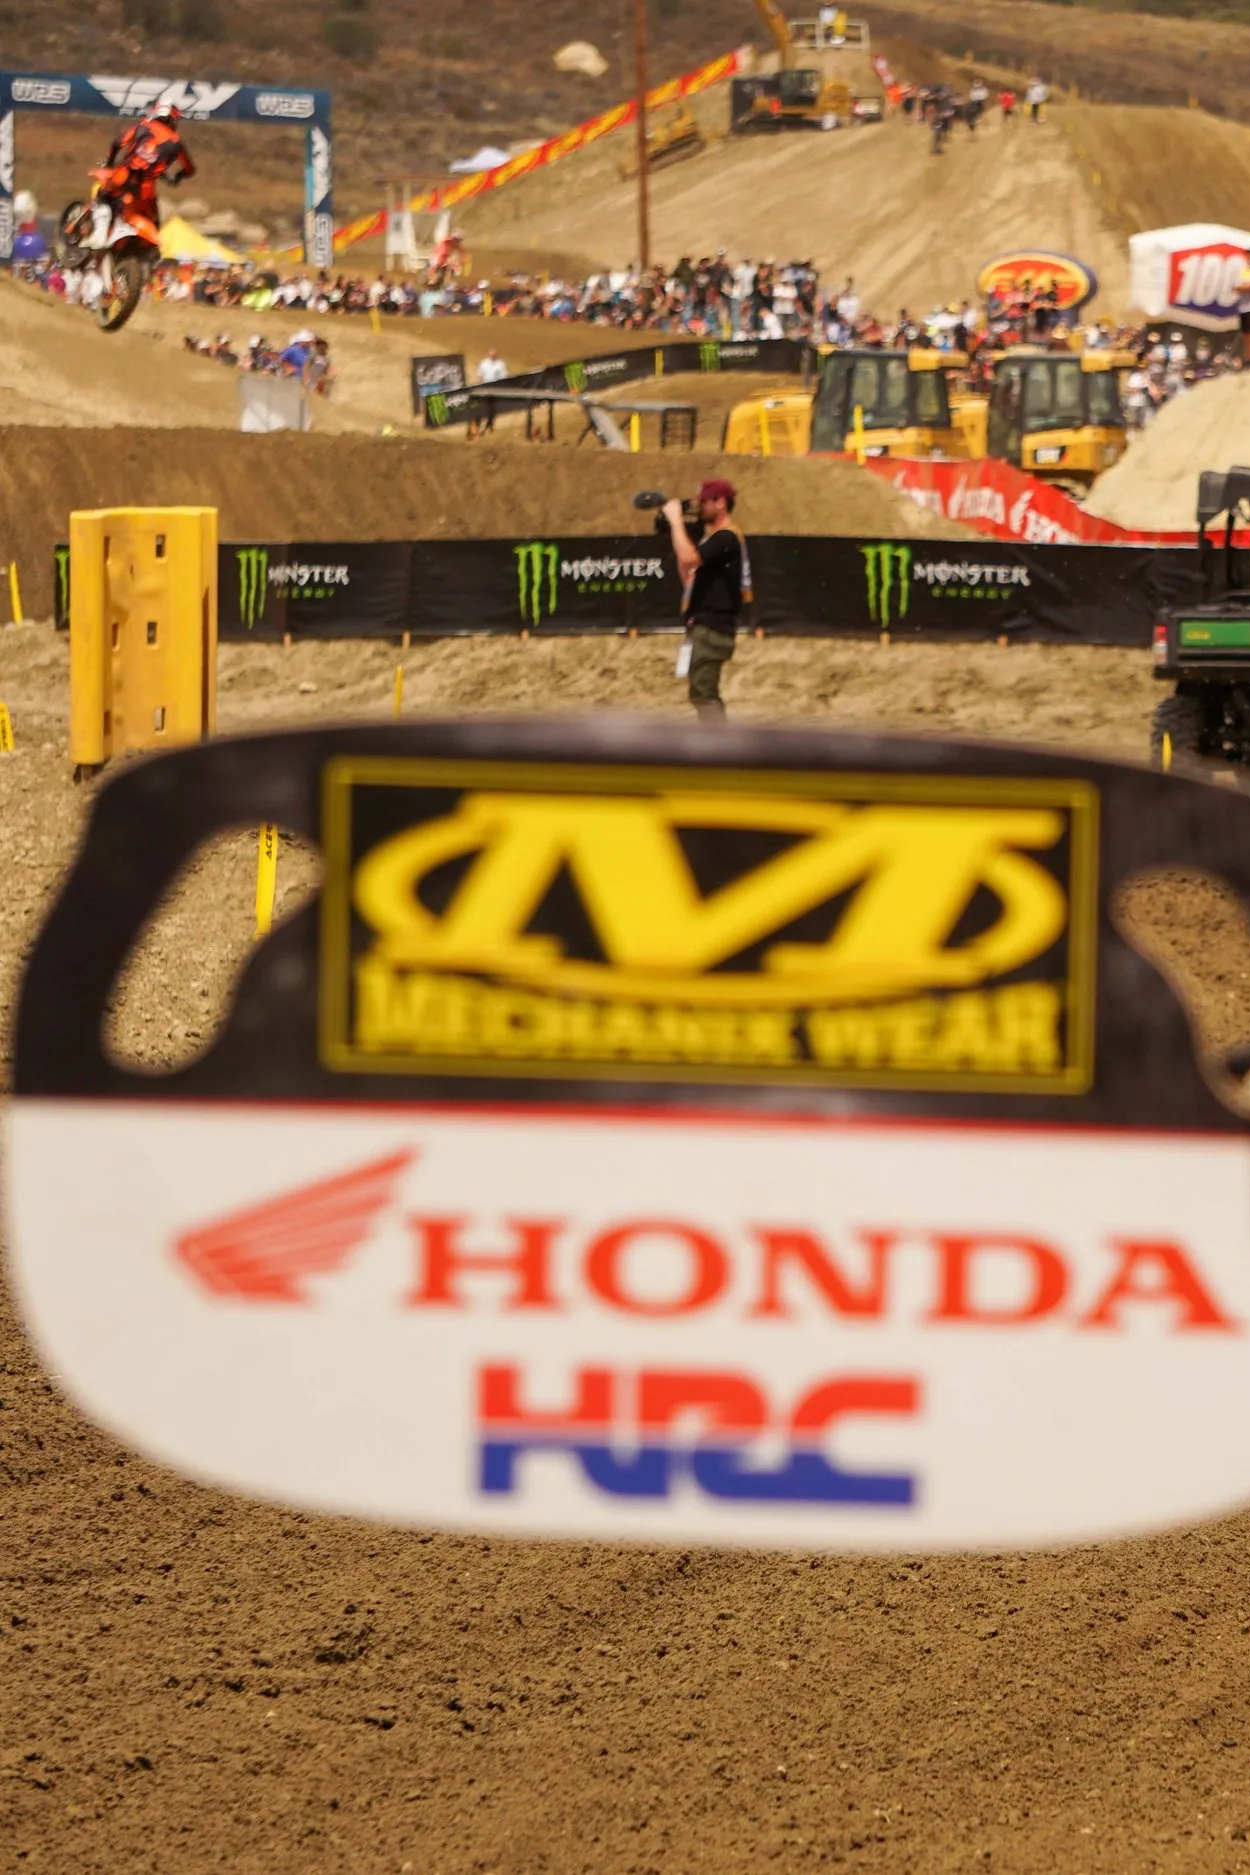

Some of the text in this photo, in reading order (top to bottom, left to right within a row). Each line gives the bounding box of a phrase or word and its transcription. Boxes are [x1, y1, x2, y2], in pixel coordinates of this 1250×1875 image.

[560, 556, 664, 581] MONSTER
[913, 560, 1031, 587] MONSTER
[806, 978, 1064, 1070] WEAR
[408, 1214, 1244, 1336] HONDA
[472, 1357, 927, 1509] HRC
